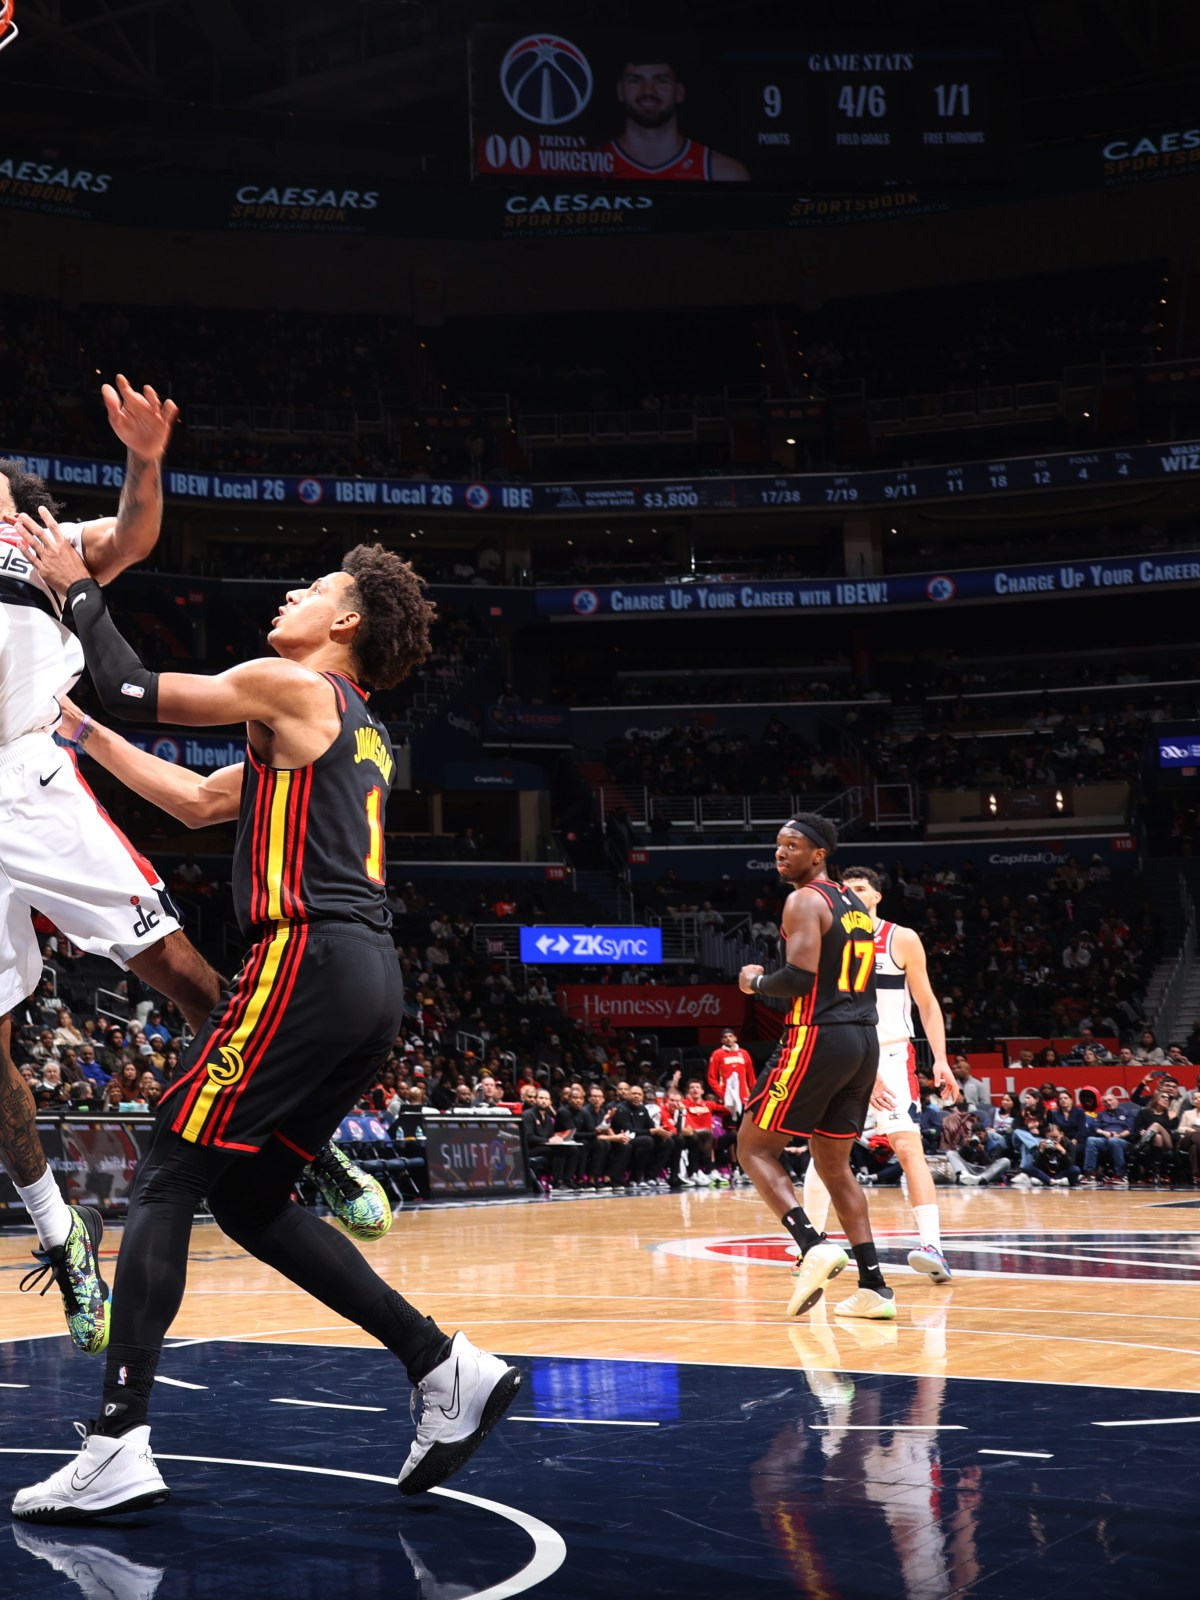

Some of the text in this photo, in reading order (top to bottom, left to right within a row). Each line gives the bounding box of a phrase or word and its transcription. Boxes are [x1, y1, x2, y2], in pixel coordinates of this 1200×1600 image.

[808, 52, 914, 73] GAME STATS
[762, 84, 783, 119] 9
[837, 84, 887, 118] 4/6
[933, 83, 971, 117] 1/1
[757, 132, 791, 145] POINTS
[836, 132, 891, 145] FIELD GOALS
[922, 131, 985, 145] FREE THROWS
[485, 134, 532, 169] 00
[538, 149, 616, 174] VUKCEVIC
[236, 186, 380, 209] CAESARS
[232, 204, 349, 222] SPORTSBOOK
[504, 210, 625, 228] SPORTSBOOK
[54, 459, 97, 485] Local
[102, 465, 124, 488] 26
[1033, 471, 1051, 484] 12
[1078, 468, 1089, 480] 4
[1118, 464, 1129, 476] 4
[170, 472, 285, 502] IBEW Local 26
[884, 485, 918, 500] 9/11
[947, 479, 964, 492] 11
[989, 475, 1008, 488] 18
[335, 481, 453, 506] IBEW Local 26
[501, 487, 533, 509] IBE
[643, 492, 698, 508] $3,800
[761, 490, 800, 504] 17/38
[825, 489, 858, 502] 7/19
[836, 582, 888, 606] IBEW!
[354, 726, 393, 786] JOHNSON
[366, 785, 386, 886] 1
[572, 934, 649, 960] ZKsync
[838, 940, 875, 992] 17
[584, 993, 722, 1019] Hennessy Lofts
[441, 1143, 489, 1169] SHIFT
